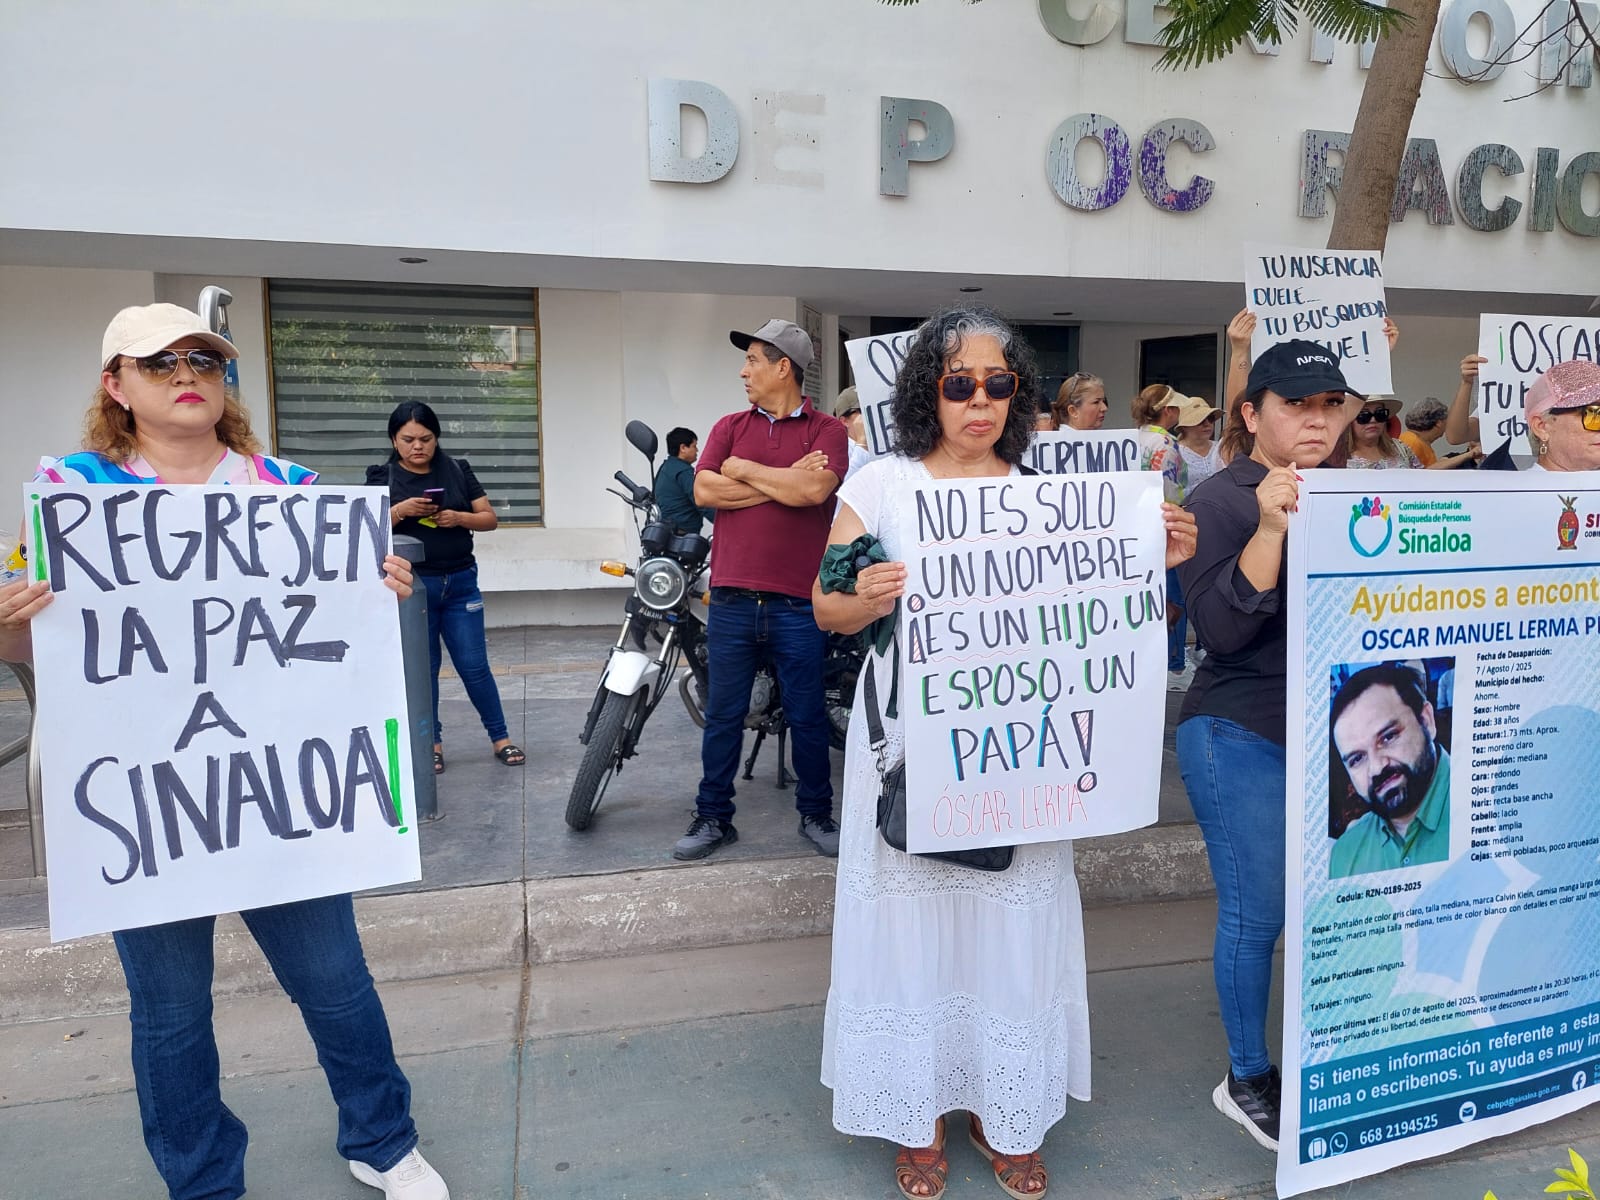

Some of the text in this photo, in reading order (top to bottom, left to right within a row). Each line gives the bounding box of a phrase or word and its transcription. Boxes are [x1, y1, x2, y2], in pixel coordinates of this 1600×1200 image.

[1259, 255, 1382, 279] TU AUSENCIA
[1262, 300, 1388, 336] TU BUSQUEDA
[1296, 355, 1334, 367] NASA
[1482, 381, 1512, 413] TU
[915, 481, 1115, 542] NO ES SOLO
[1399, 501, 1462, 510] Comisión Estatal de
[1399, 514, 1432, 525] Búsqueda
[1433, 514, 1441, 522] de
[30, 488, 391, 593] ¡REGRESEN
[1398, 527, 1472, 554] Sinaloa
[921, 537, 1154, 600] UN NOMBRE,
[979, 607, 1029, 649] UN
[1124, 583, 1165, 630] UN
[1350, 584, 1486, 622] Ayúdanos
[1495, 585, 1508, 607] a
[81, 595, 350, 684] LA PAZ
[1361, 617, 1579, 651] OSCAR MANUEL LERMA
[1477, 648, 1552, 661] Fecha de Desaparición:
[1084, 650, 1135, 694] UN
[1475, 675, 1544, 688] Municipio del hecho:
[1487, 662, 1532, 675] Agosto 2025
[174, 691, 247, 752] A
[1474, 702, 1520, 715] Sexo: Hombre
[1473, 716, 1519, 728] Edad: 38 años
[1536, 726, 1560, 735] Aprox.
[951, 704, 1098, 793] PAPÁ!
[1472, 741, 1534, 754] Tez: moreno claro
[1472, 753, 1548, 768] Complexión: mediana
[1471, 769, 1521, 781] Cara: redondo
[73, 718, 409, 885] SINALOA!
[1471, 782, 1519, 796] Ojos: grandes
[1471, 792, 1553, 808] Nariz: recta base ancha
[933, 784, 1089, 837] ÓSCAR LERMA
[1471, 808, 1518, 821] Cabello: lacio
[1471, 821, 1522, 835] Frente: amplia
[1471, 834, 1524, 848] Boca: mediana
[1471, 853, 1492, 862] Cejas:
[1494, 849, 1511, 858] semi
[1513, 845, 1547, 858] pobladas,
[1549, 843, 1566, 852] poco
[1336, 881, 1422, 904] Cedula: RZN-0189-2025
[1312, 880, 1593, 935] Ropa: Pantalón de color gris claro, talla mediana, marca Calvin Klein, camisa manga larga
[1312, 892, 1587, 948] frontales, marca talla mediana, tenis de color blanco con detalles color azul
[1311, 960, 1406, 986] Señas Particulares: ninguna.
[1310, 977, 1571, 1038] Visto última agosto 2025, aproximadamente 20:30
[1311, 992, 1373, 1012] Tatuajes: ninguno.
[1310, 989, 1570, 1050] Perez privado libertad, desde momento desconoce paradero.
[1309, 1013, 1600, 1091] Si tienes información referente a esta
[1309, 1038, 1584, 1114] llama o escribenos. Tu ayuda es muy
[1359, 1127, 1382, 1145] 668
[1386, 1114, 1438, 1139] 2194525
